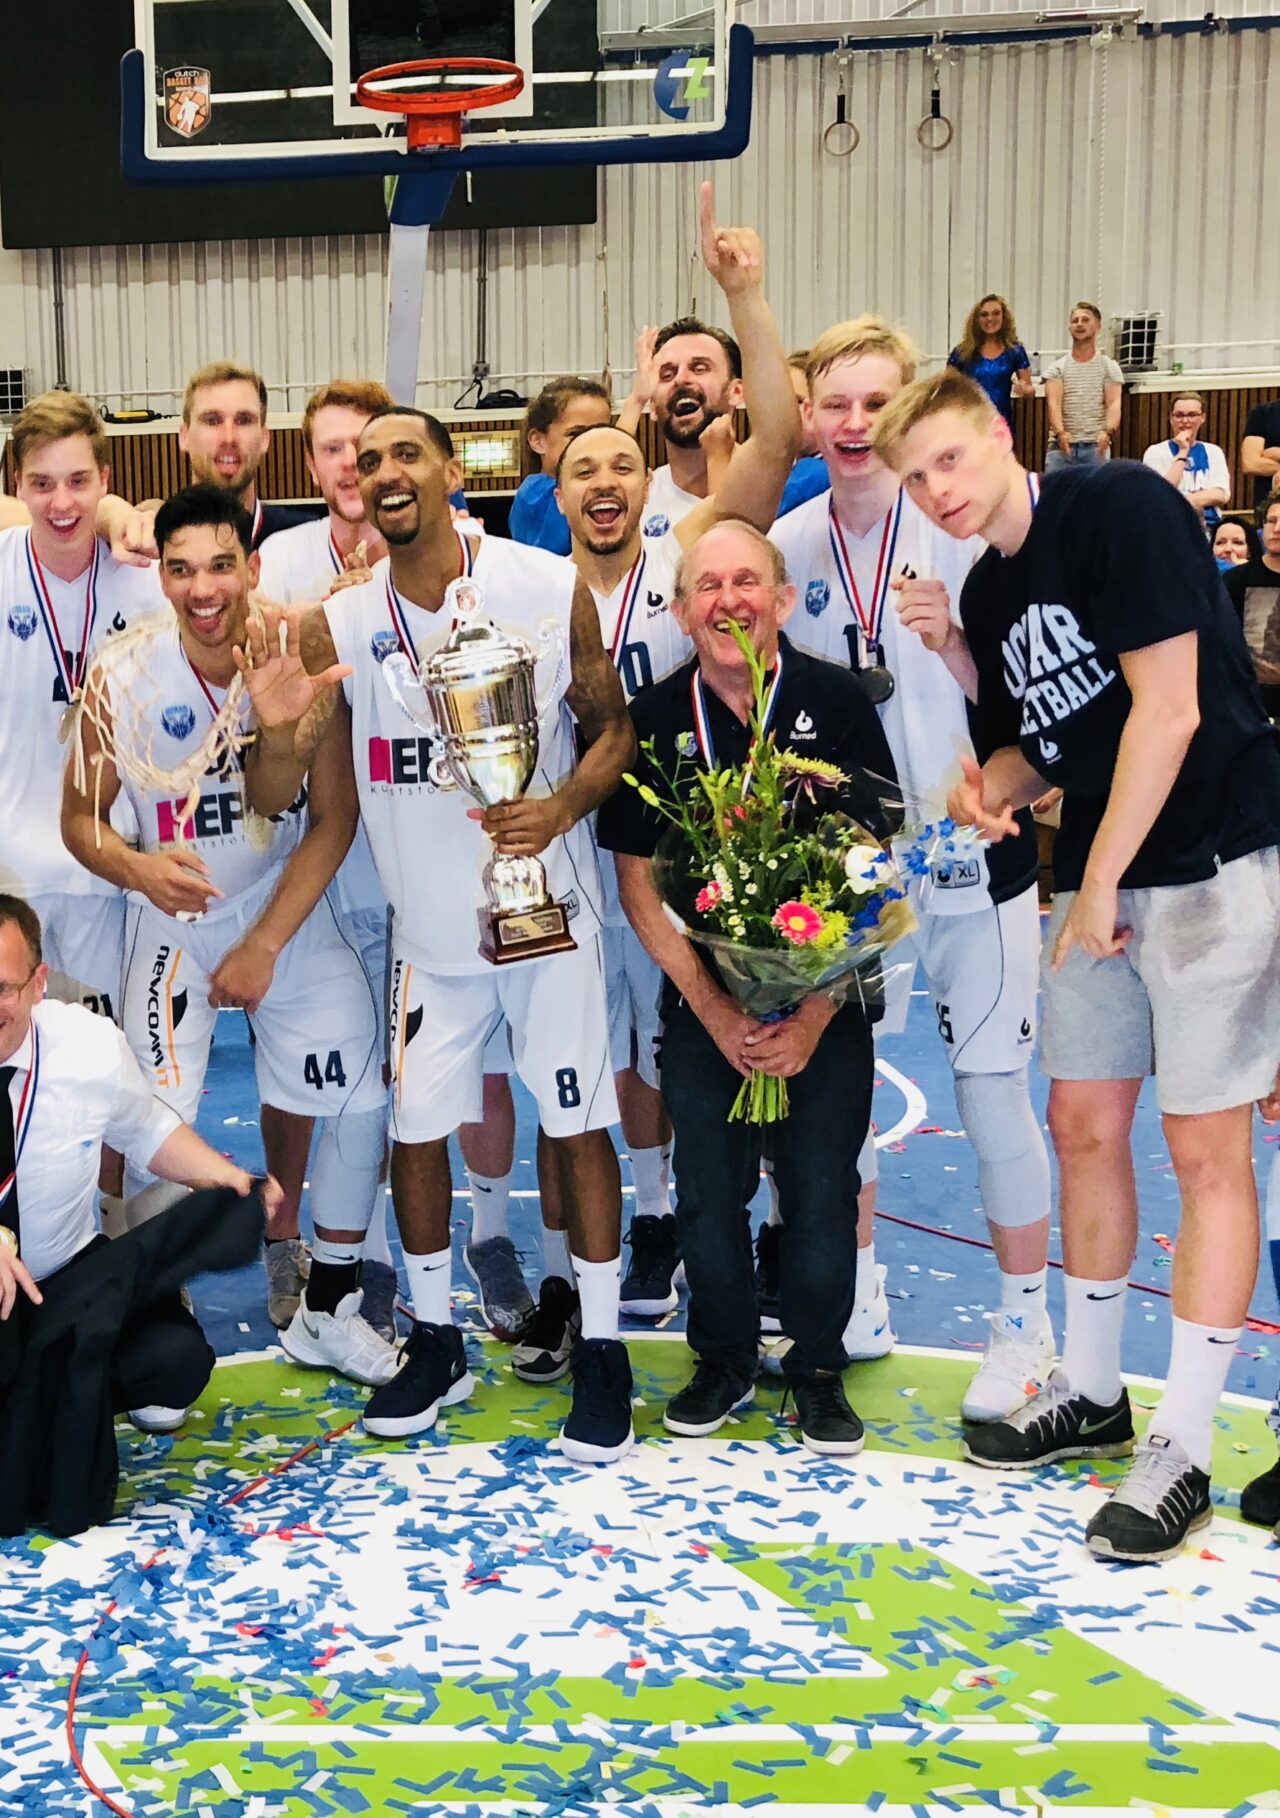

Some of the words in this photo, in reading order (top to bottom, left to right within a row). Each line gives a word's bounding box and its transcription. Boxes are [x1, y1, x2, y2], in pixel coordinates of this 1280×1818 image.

[958, 865, 976, 878] XL
[156, 1067, 170, 1089] IT
[304, 1050, 346, 1090] 44
[555, 1067, 581, 1108] 8
